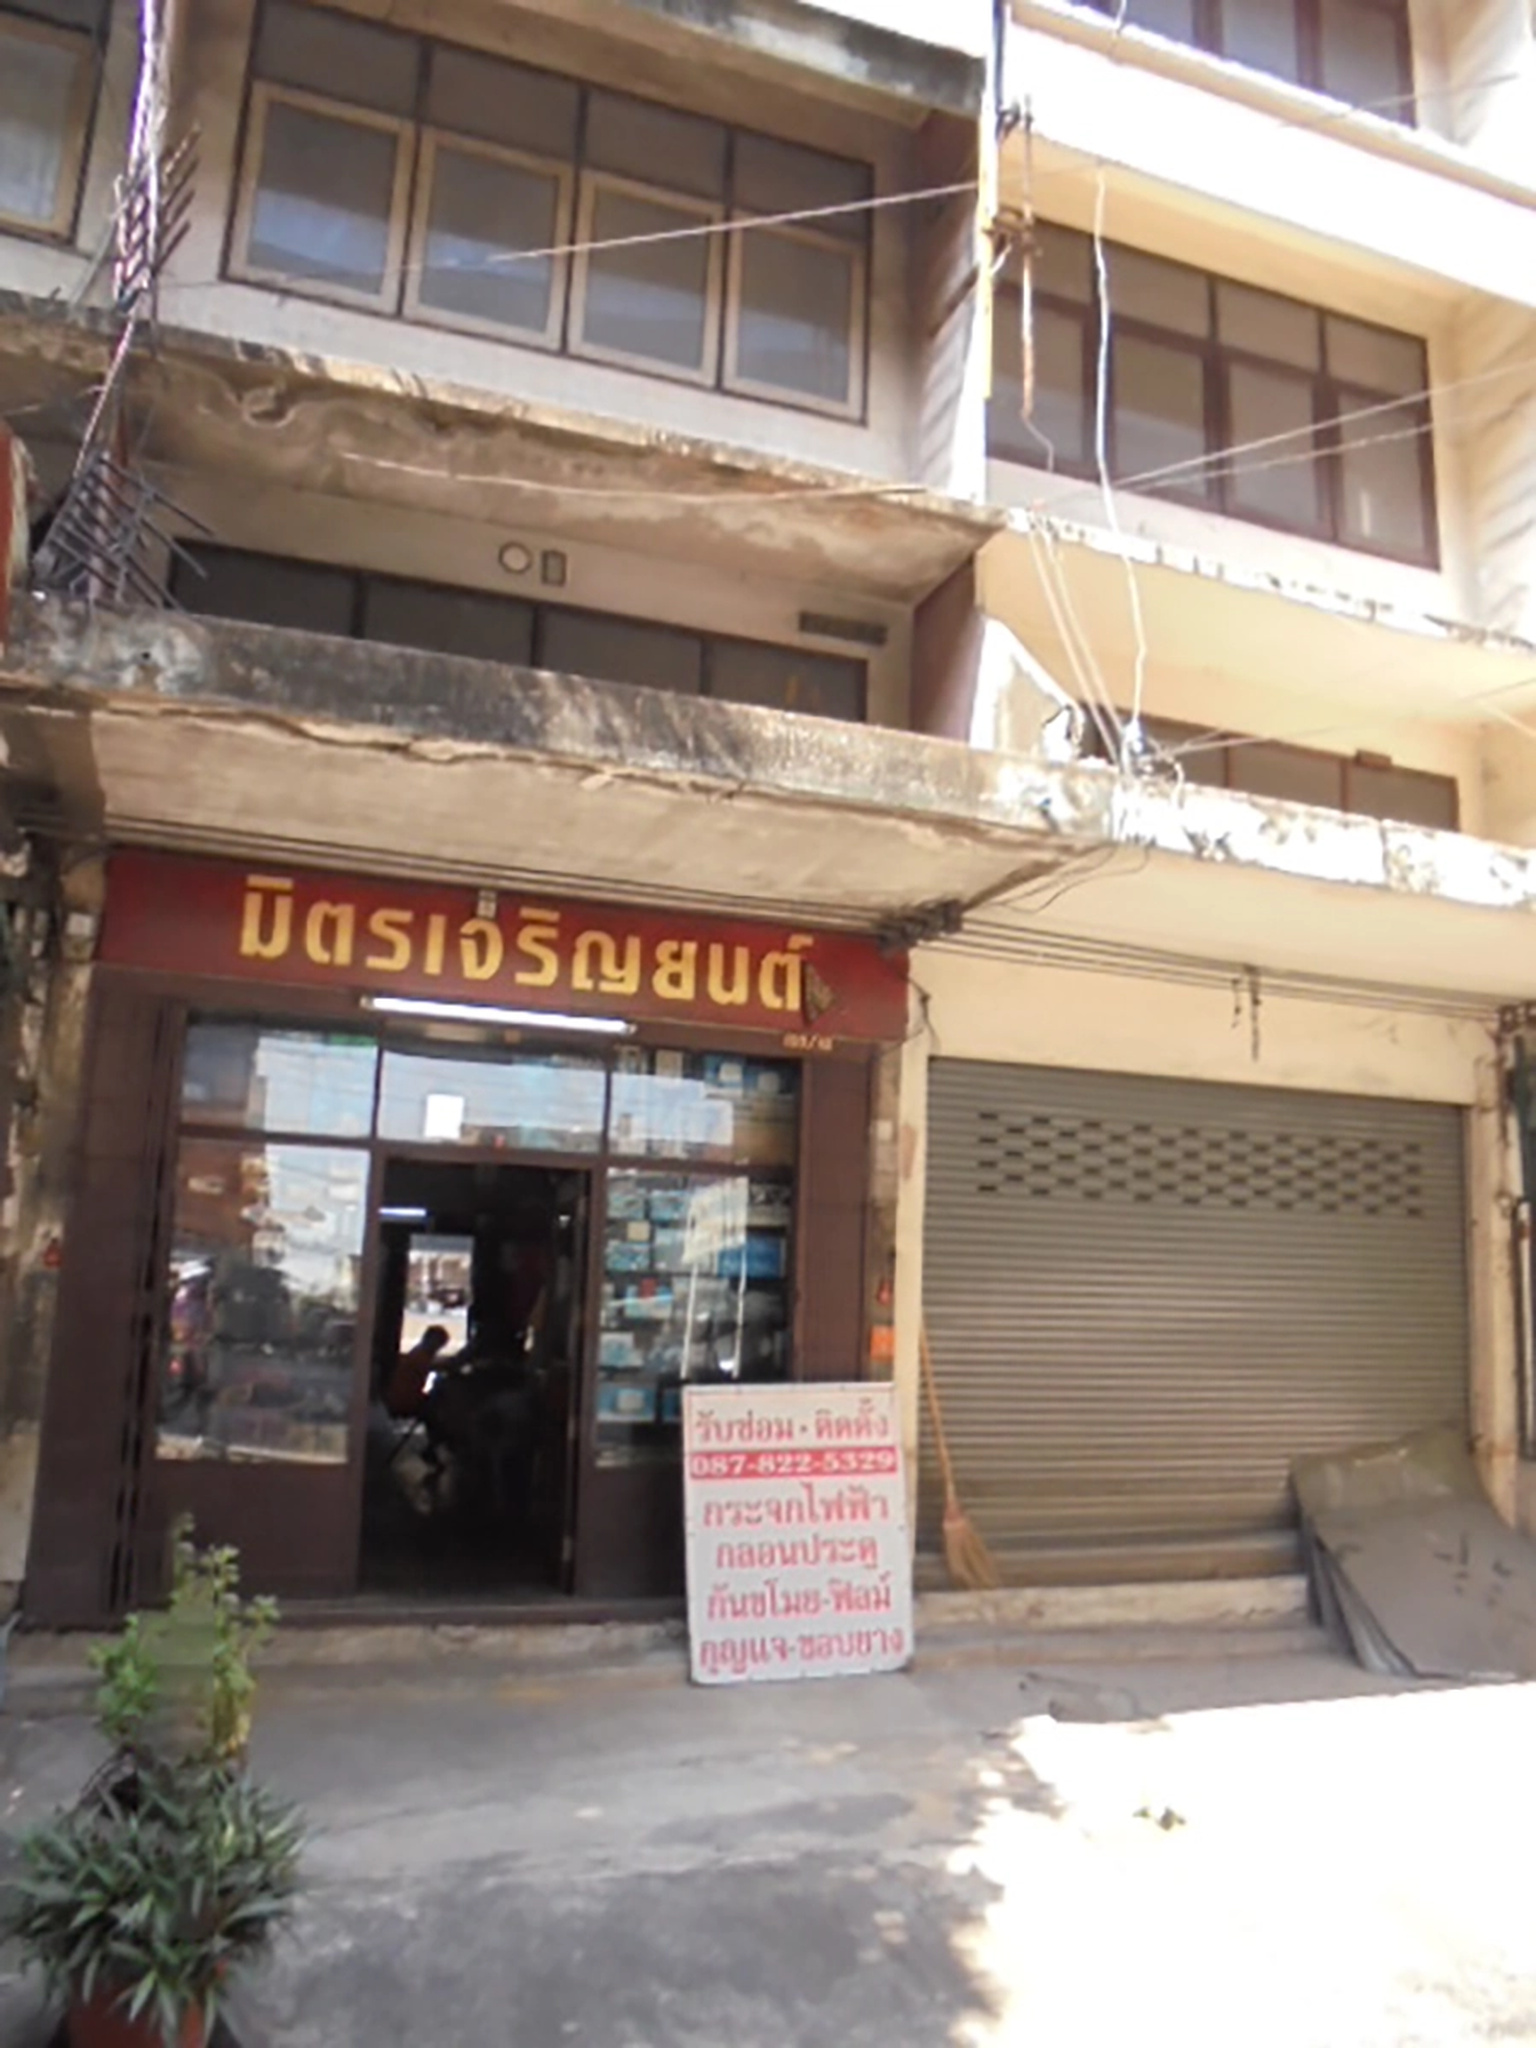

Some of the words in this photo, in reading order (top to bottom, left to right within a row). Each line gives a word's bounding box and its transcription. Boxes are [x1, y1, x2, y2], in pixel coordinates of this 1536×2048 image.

[239, 875, 813, 1011] มิตรเจริญยนต์
[703, 1482, 888, 1526] กระจกไฟฟ้า
[716, 1533, 878, 1569] กลอนประตู
